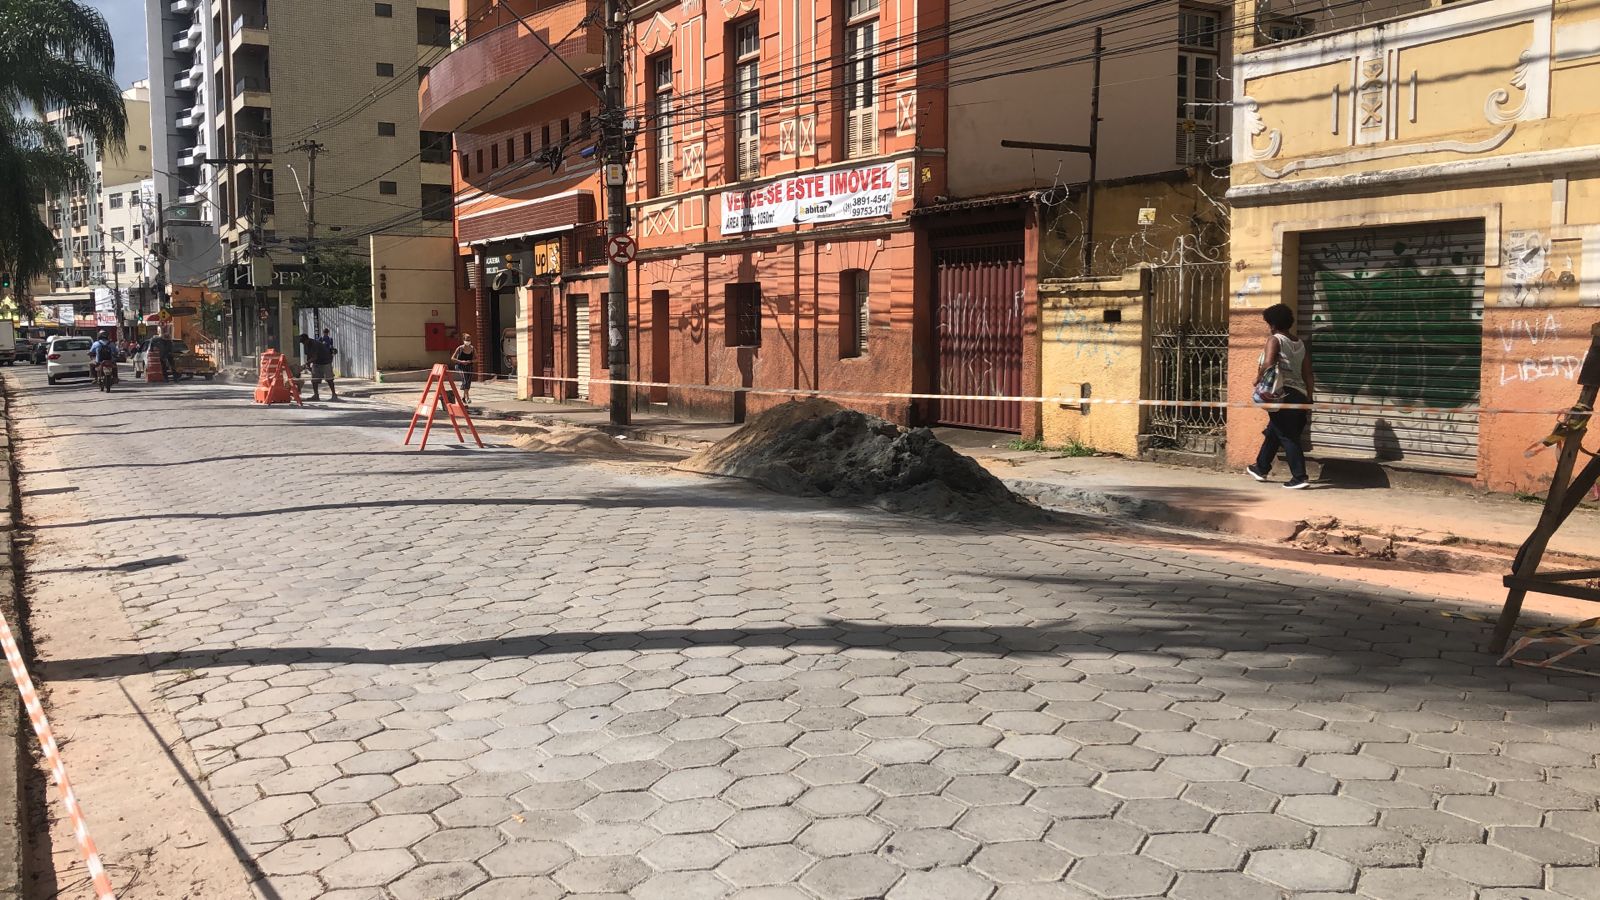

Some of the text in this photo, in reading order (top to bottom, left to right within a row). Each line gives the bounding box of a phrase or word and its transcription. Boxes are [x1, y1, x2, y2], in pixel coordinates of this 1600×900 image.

[726, 183, 783, 212] VENDE-SE
[786, 175, 825, 201] ESTE
[829, 167, 892, 196] IMÓVEL
[725, 214, 739, 229] ÁREA
[1497, 313, 1562, 353] VIVA
